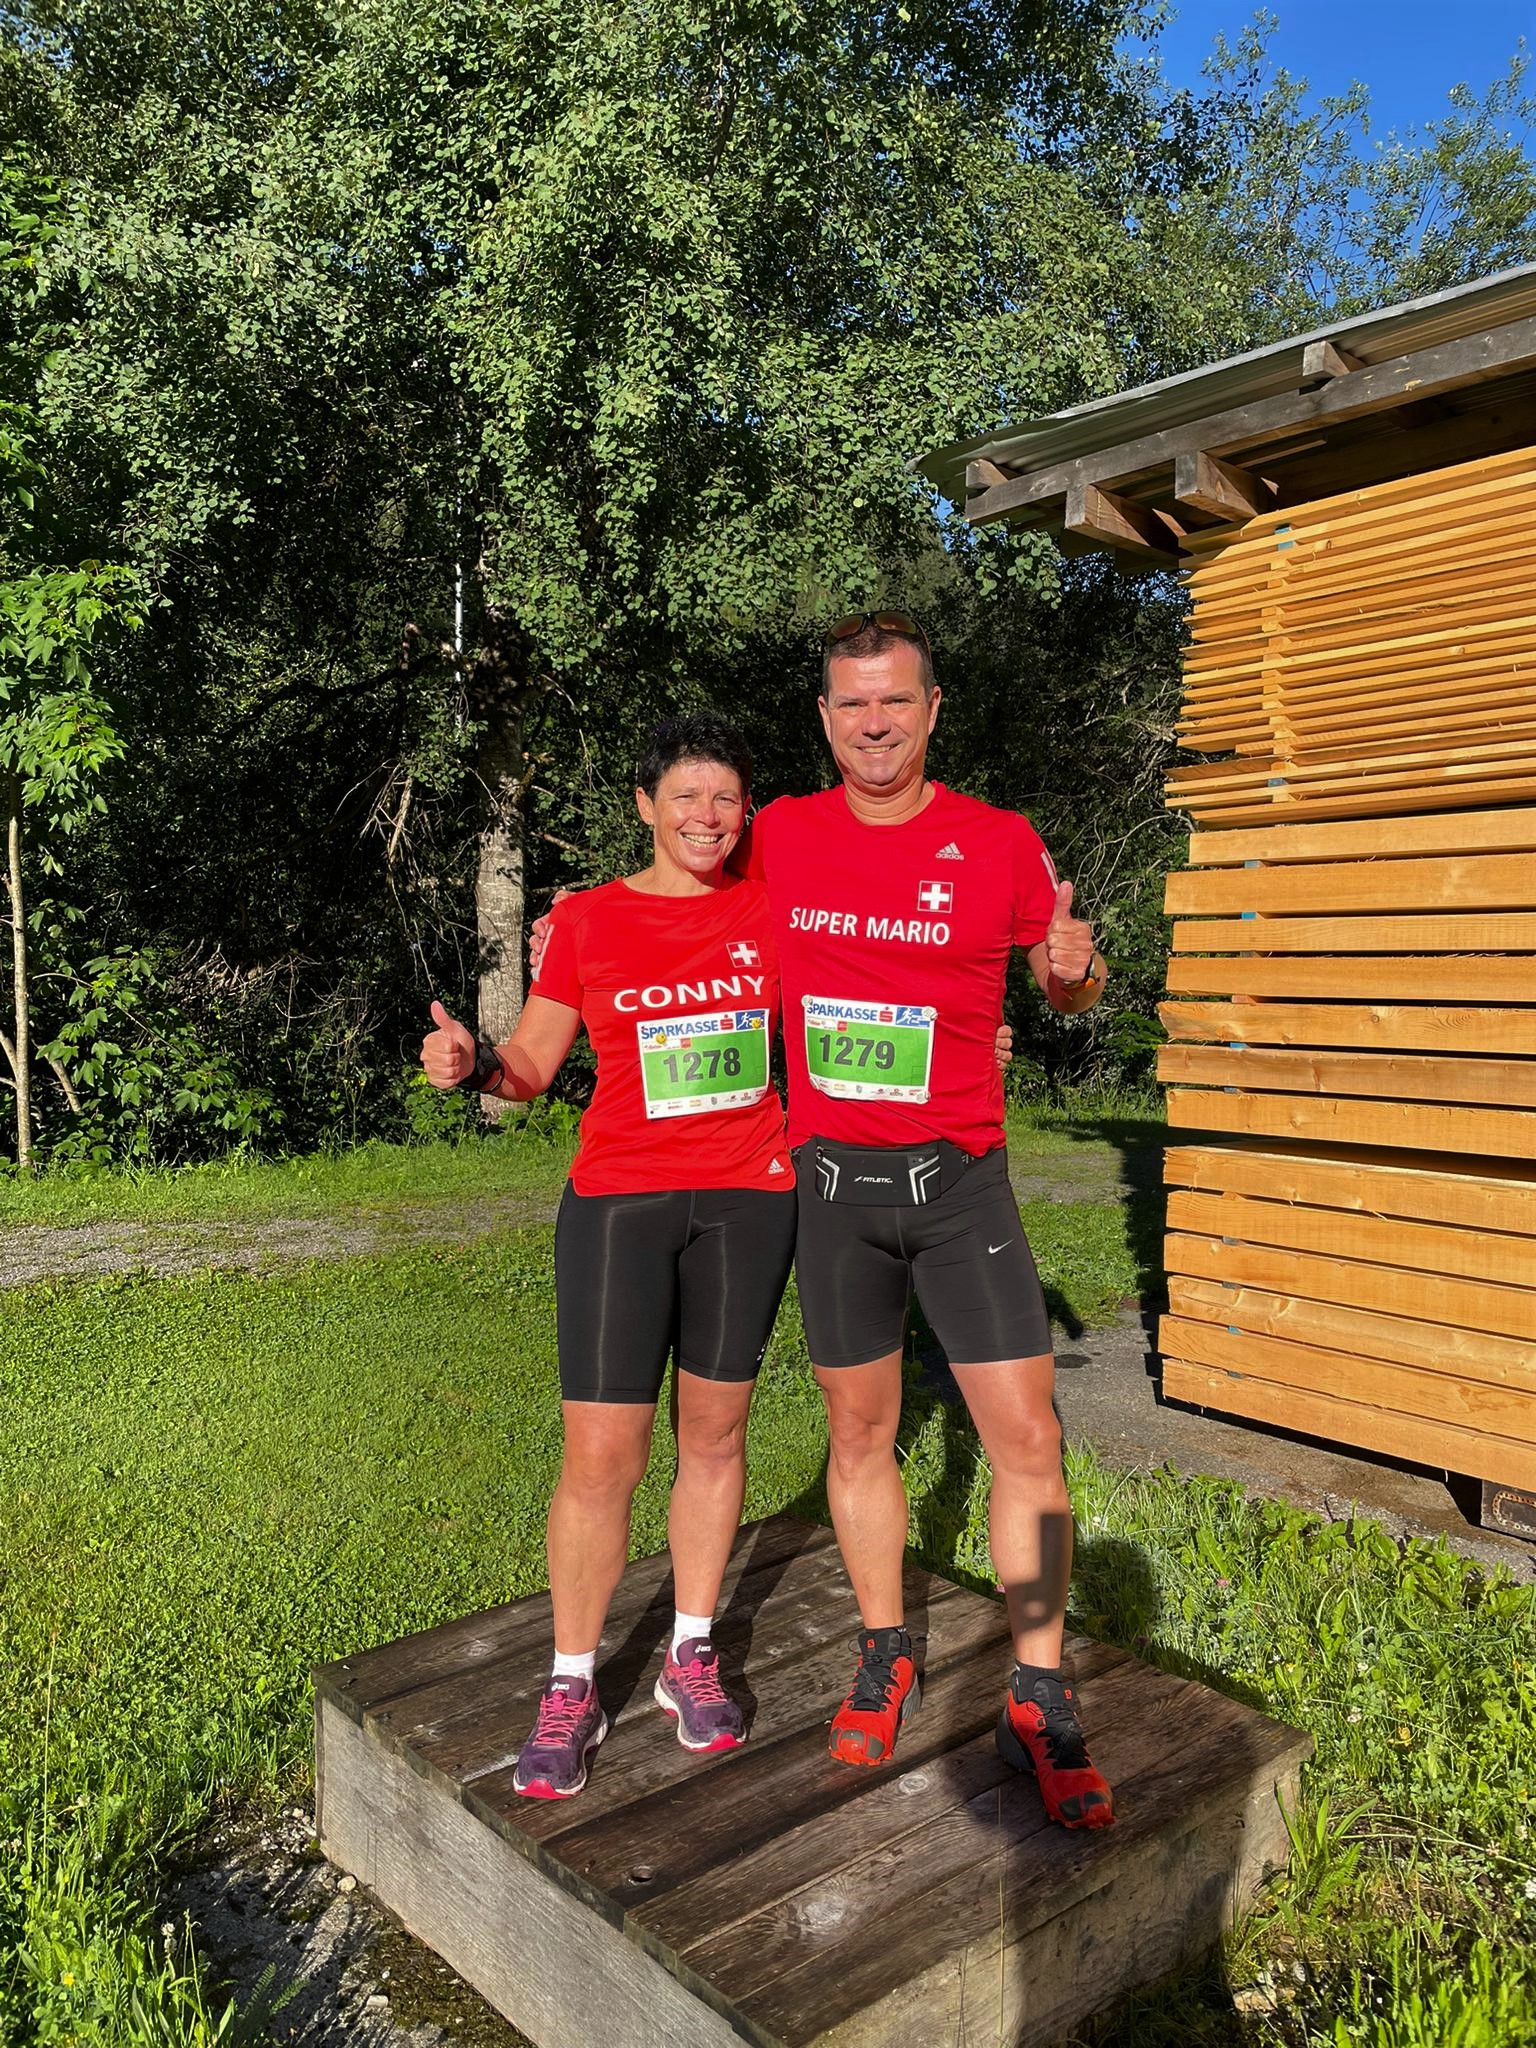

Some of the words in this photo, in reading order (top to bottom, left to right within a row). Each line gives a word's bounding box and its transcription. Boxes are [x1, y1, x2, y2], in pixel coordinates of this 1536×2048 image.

[935, 852, 965, 861] adidas
[789, 907, 858, 937] SUPER
[866, 916, 950, 946] MARIO
[613, 975, 765, 1013] CONNY
[641, 1019, 719, 1040] SPARKASSE
[663, 1047, 741, 1083] 1278
[819, 1034, 895, 1070] 1279
